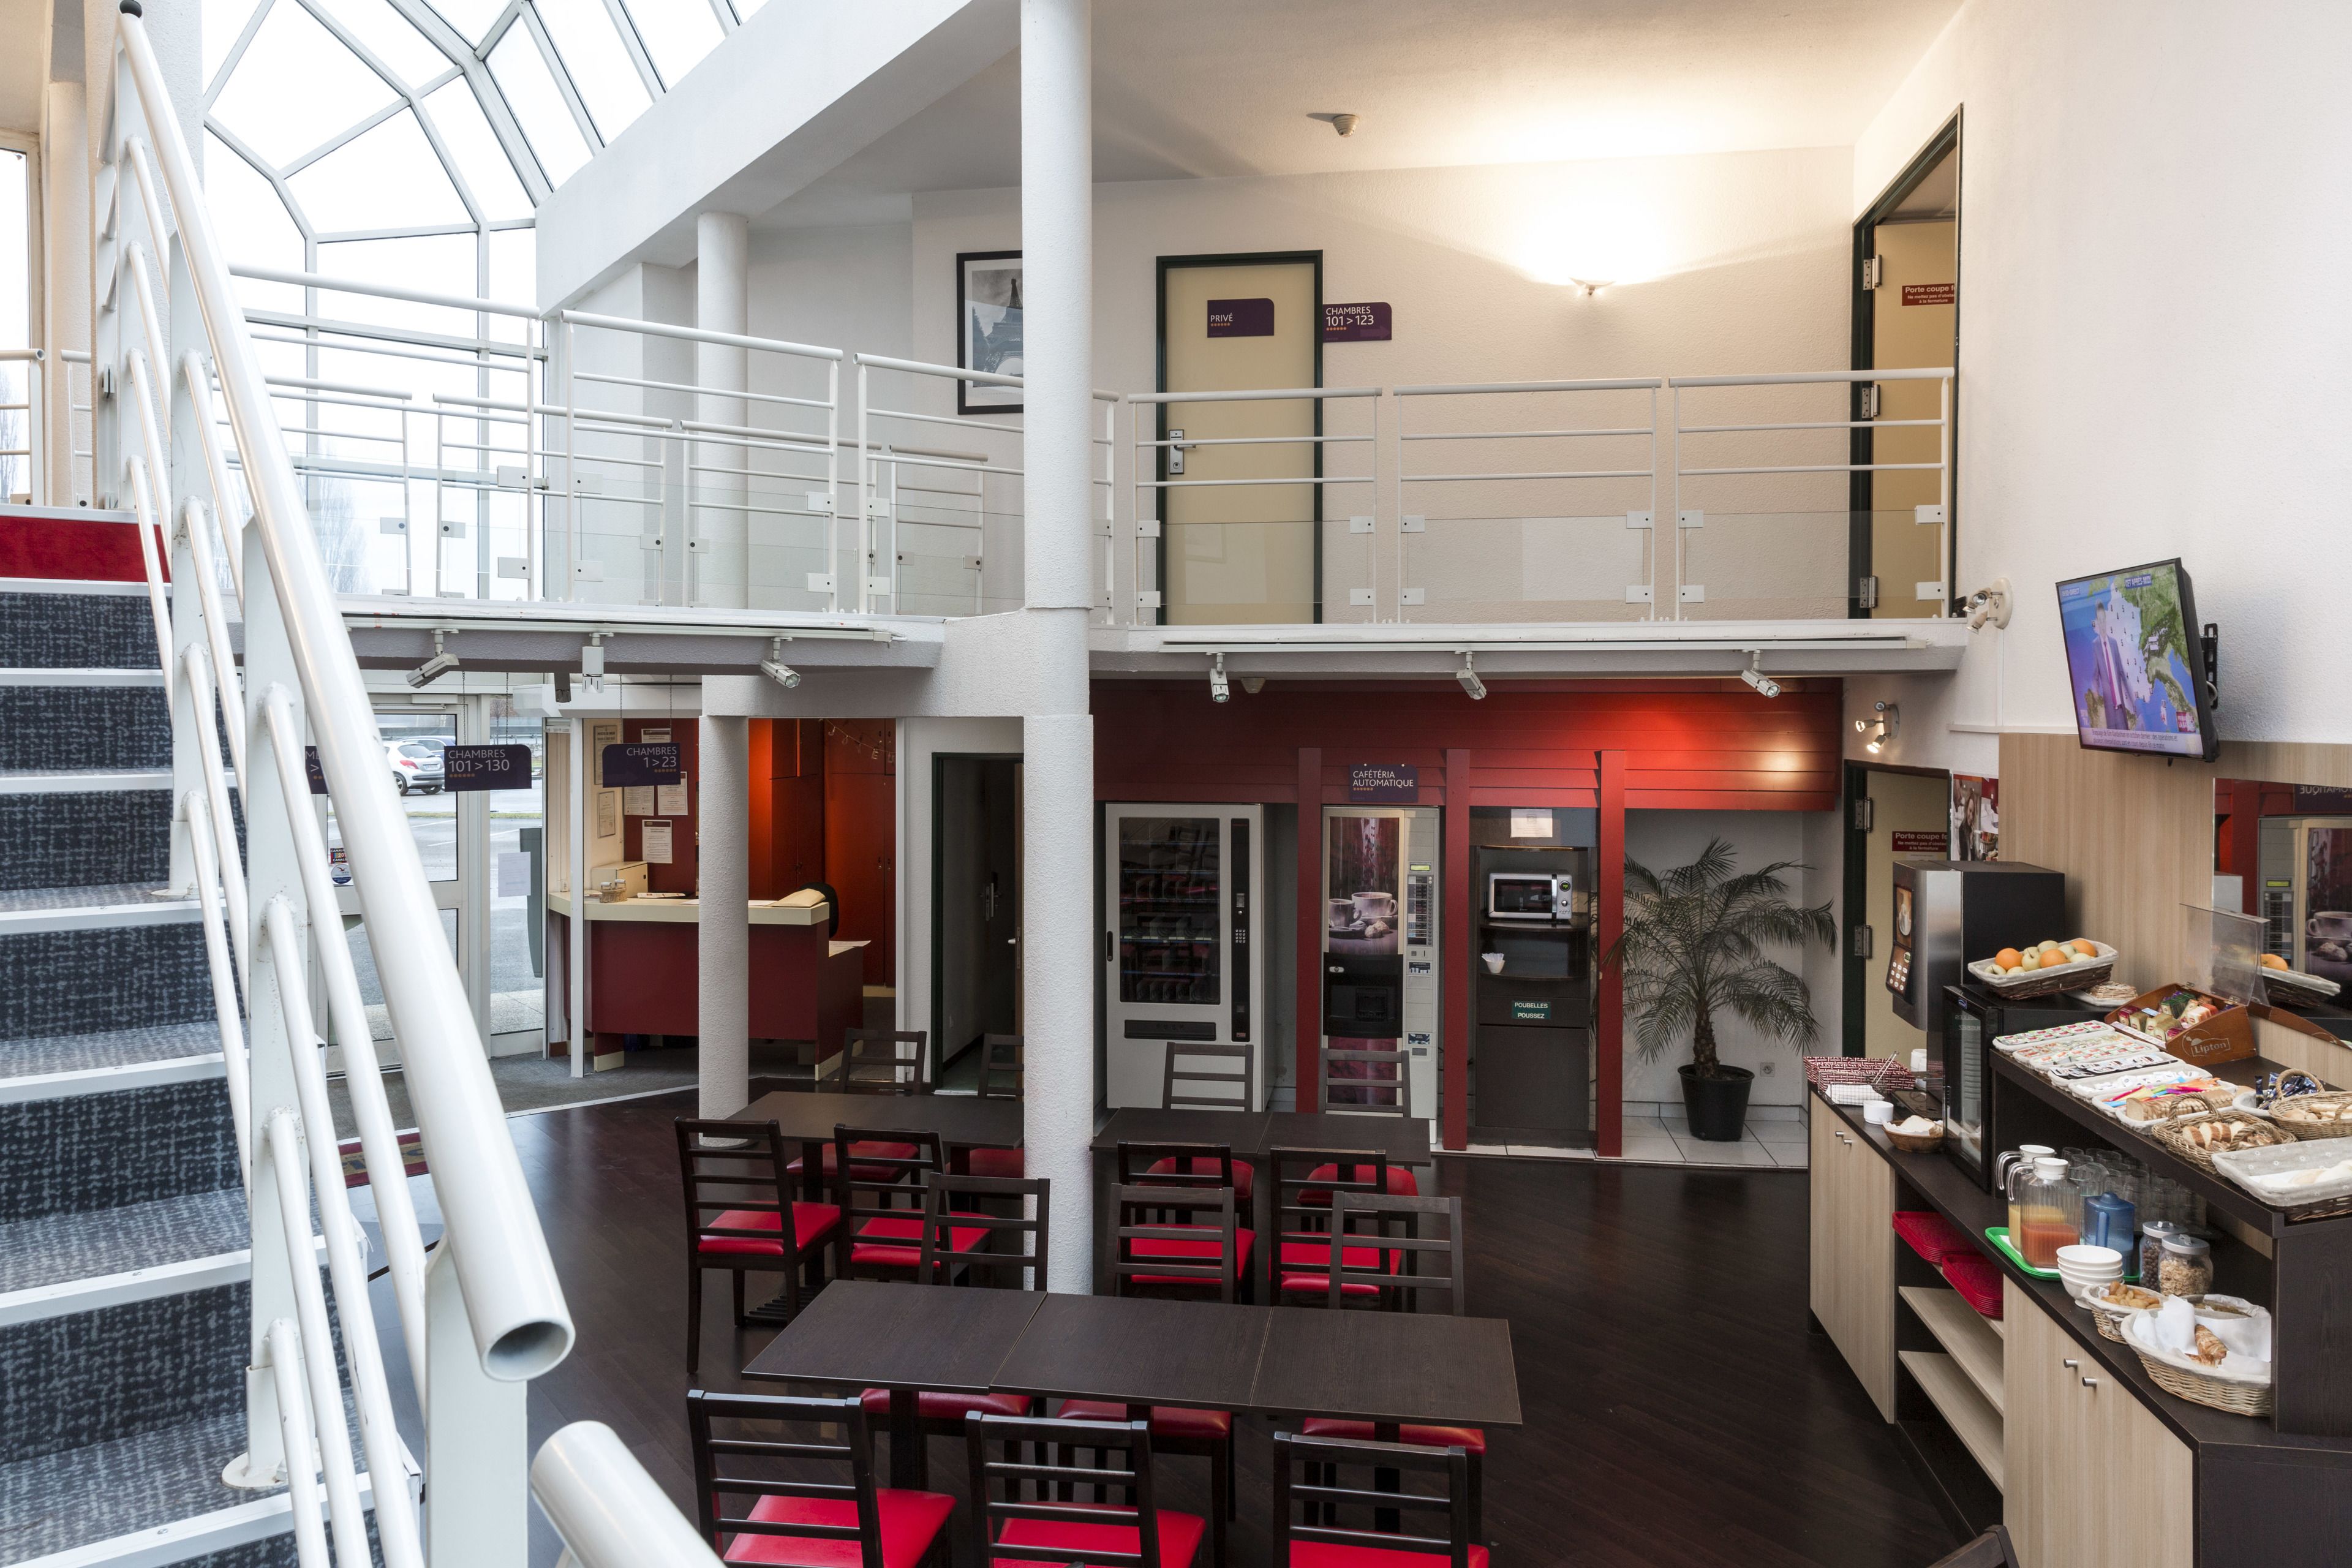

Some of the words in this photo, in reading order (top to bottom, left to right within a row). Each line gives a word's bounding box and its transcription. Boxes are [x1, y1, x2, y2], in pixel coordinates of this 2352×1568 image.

[1325, 306, 1371, 315] CHAMBRES
[1210, 312, 1233, 322] PRIVÉ
[448, 749, 505, 759] CHAMBRES
[627, 747, 677, 756] CHAMBRES
[1352, 769, 1395, 778] CAFÉTÉRIA
[1352, 779, 1414, 788] AUTOMATIQUE
[2194, 1042, 2226, 1054] Lipton
